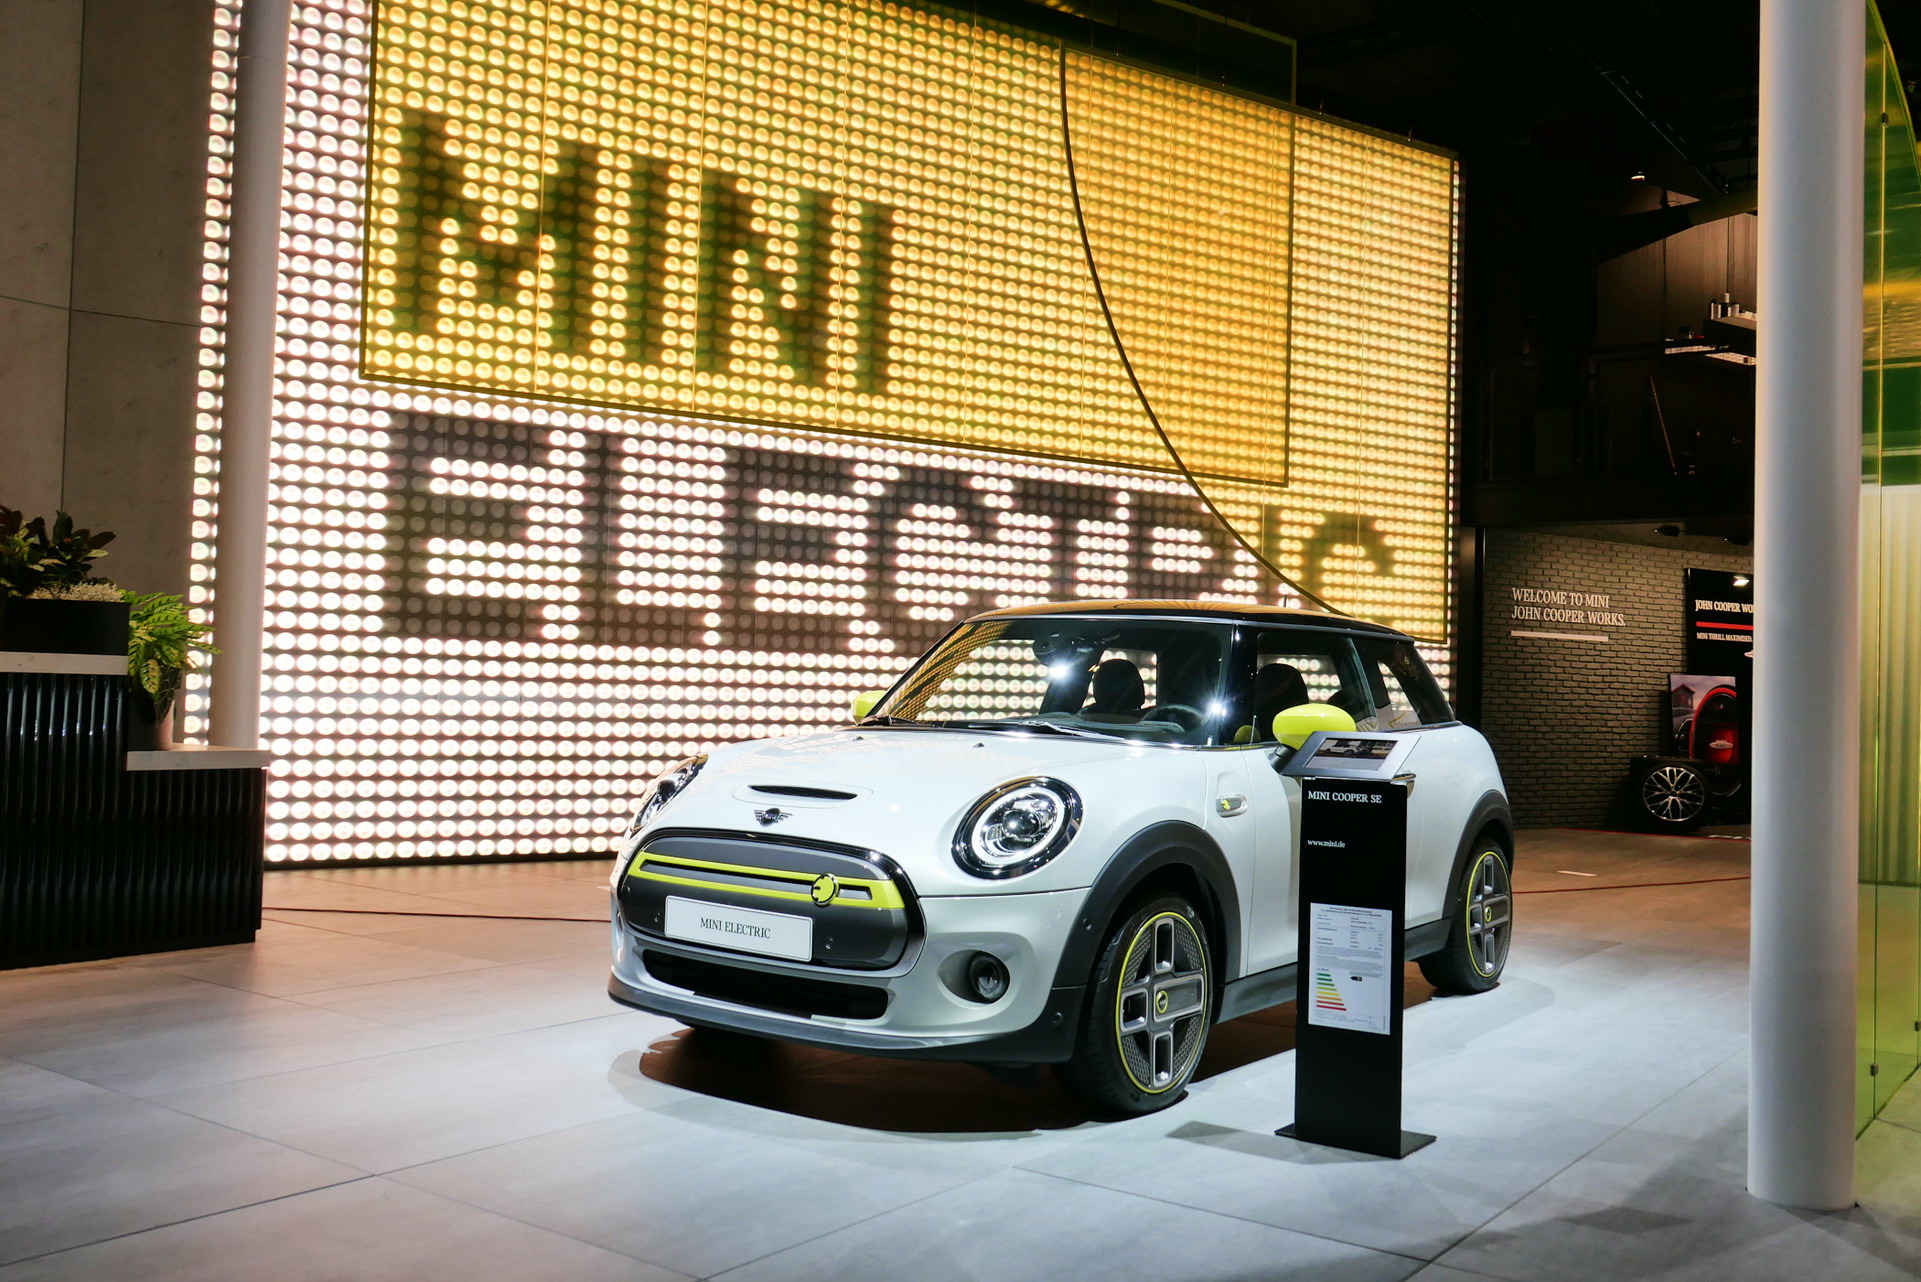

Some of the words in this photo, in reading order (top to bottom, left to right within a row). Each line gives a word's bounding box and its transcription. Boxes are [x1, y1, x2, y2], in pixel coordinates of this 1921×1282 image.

[399, 108, 893, 394] MINI
[387, 409, 1400, 656] ELECTRIC
[1512, 587, 1567, 604] WELCOME
[1569, 592, 1583, 605] TO
[1585, 593, 1610, 608] MINI
[1695, 599, 1713, 611] JOHN
[1713, 601, 1741, 612] COOPER
[1511, 605, 1541, 619] JOHN
[1543, 608, 1585, 622] COOPER
[1587, 611, 1626, 626] WORKS.
[1308, 790, 1330, 800] MINI
[1332, 792, 1369, 802] COOPER
[1370, 794, 1382, 803] SE
[1307, 839, 1346, 848] www.mini.de
[700, 917, 722, 930] MINI
[724, 921, 771, 938] ELECTRIC
